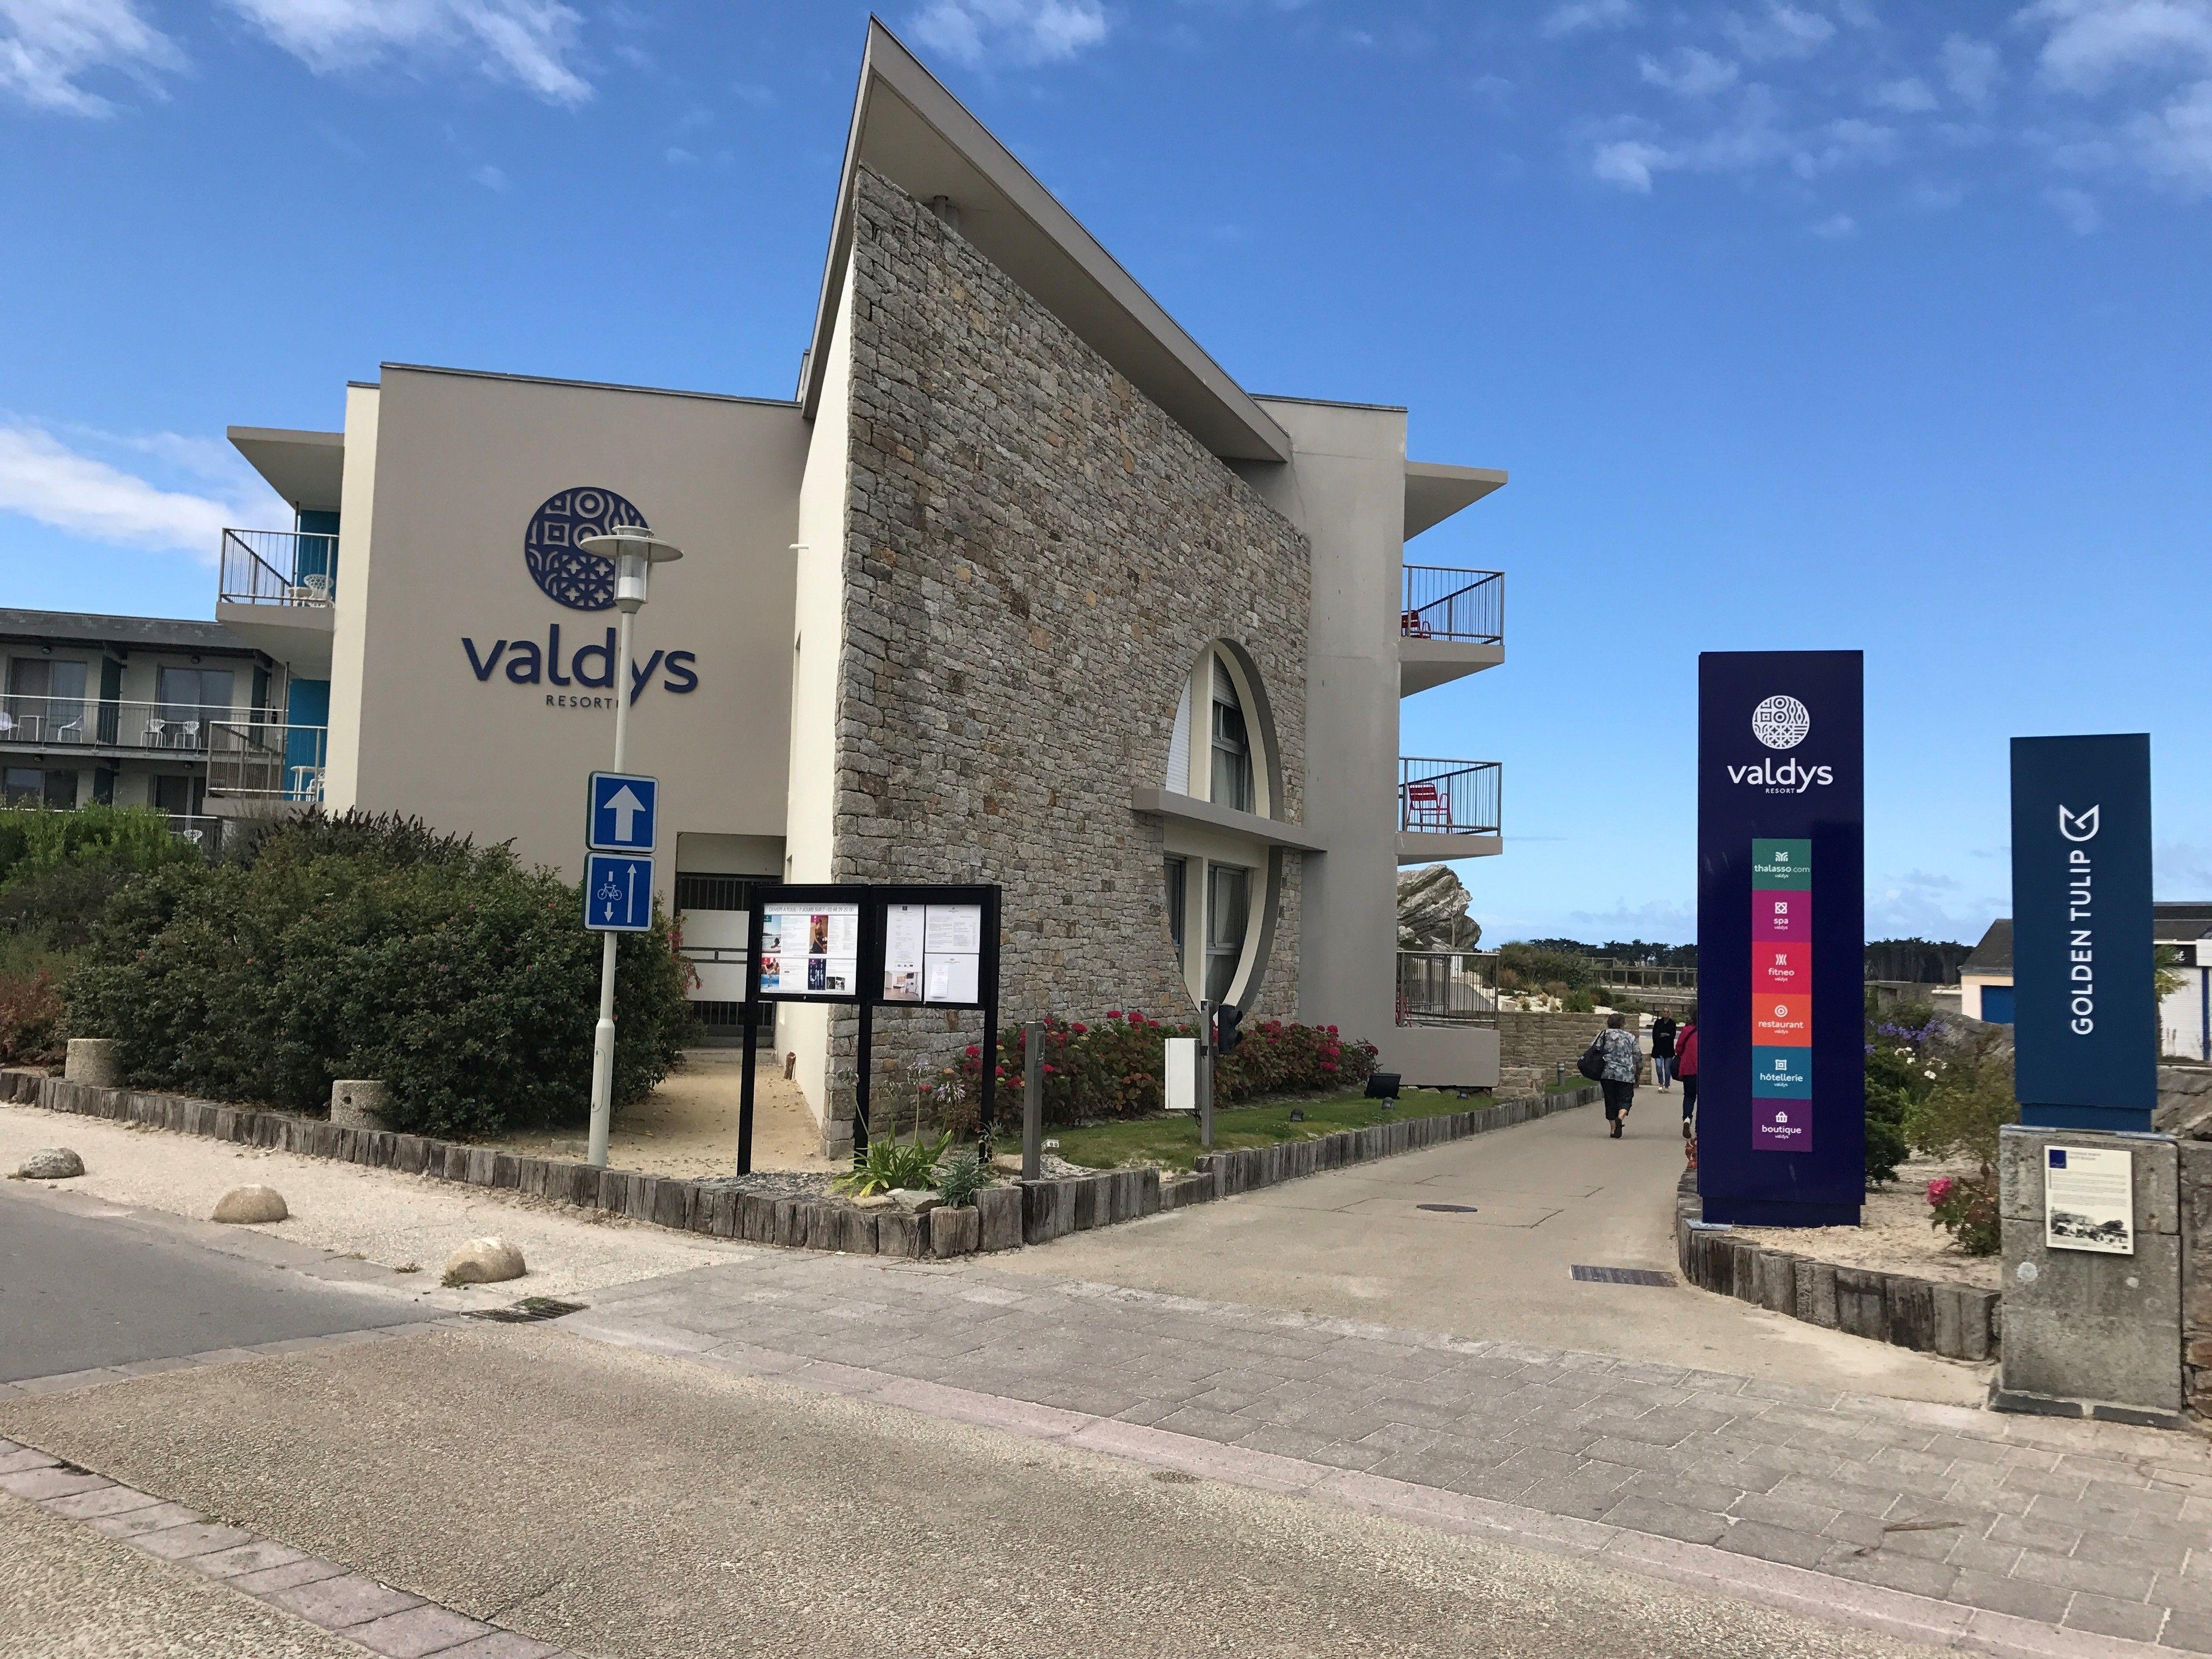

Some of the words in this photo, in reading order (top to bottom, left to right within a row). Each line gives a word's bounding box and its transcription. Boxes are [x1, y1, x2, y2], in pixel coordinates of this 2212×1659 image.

[546, 695, 612, 709] RESORT
[1727, 757, 1834, 793] valdys
[2069, 850, 2091, 921] TULIP
[1768, 967, 1795, 976] fitneo
[2070, 930, 2094, 1035] GOLDEN
[1758, 1020, 1804, 1029] restaurant
[1760, 1073, 1803, 1082] hôtellerie
[1762, 1124, 1802, 1135] boutique
